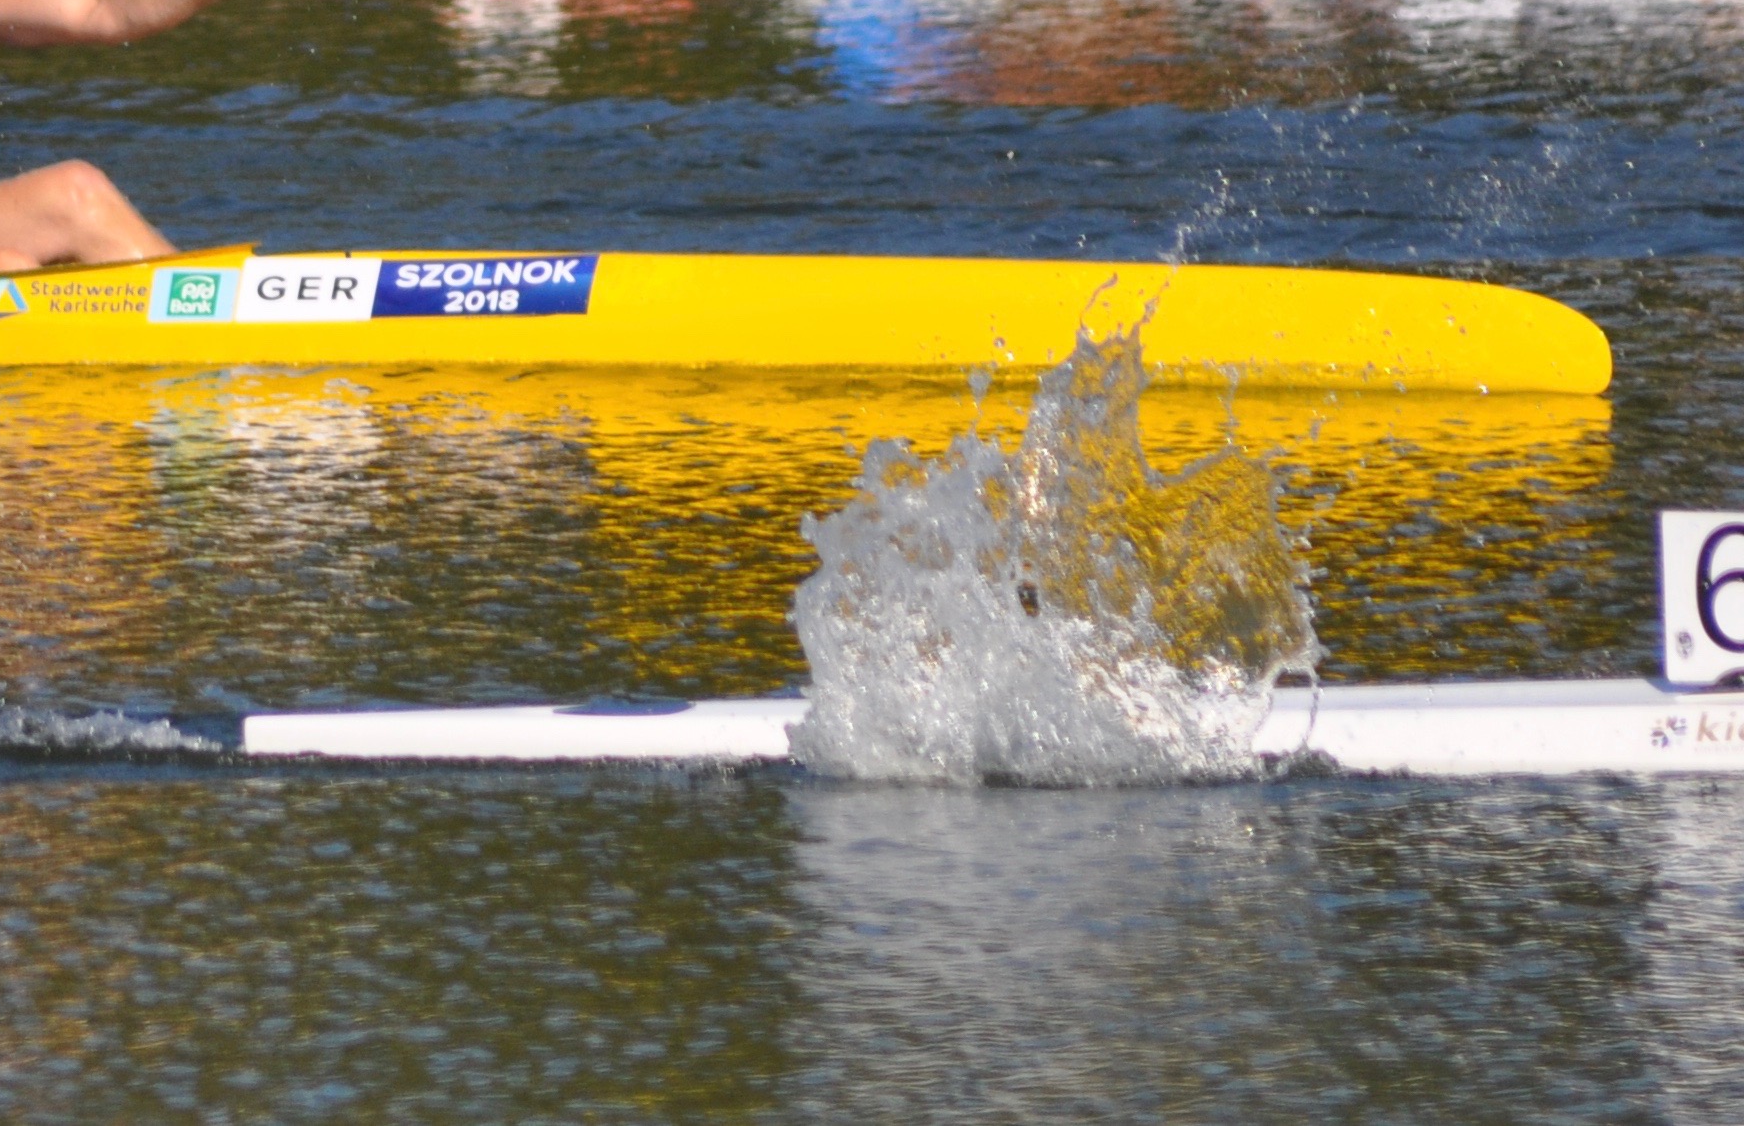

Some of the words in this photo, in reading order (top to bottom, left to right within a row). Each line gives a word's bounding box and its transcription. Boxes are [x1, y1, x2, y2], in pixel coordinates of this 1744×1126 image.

[394, 259, 581, 288] SZOLNOK
[30, 280, 149, 297] Stadtwerke
[256, 275, 359, 301] GER
[49, 297, 146, 314] Karlsruhe
[169, 298, 213, 314] Bank
[443, 289, 520, 313] 2018
[1696, 521, 1744, 653] 6
[1696, 710, 1744, 742] ki
